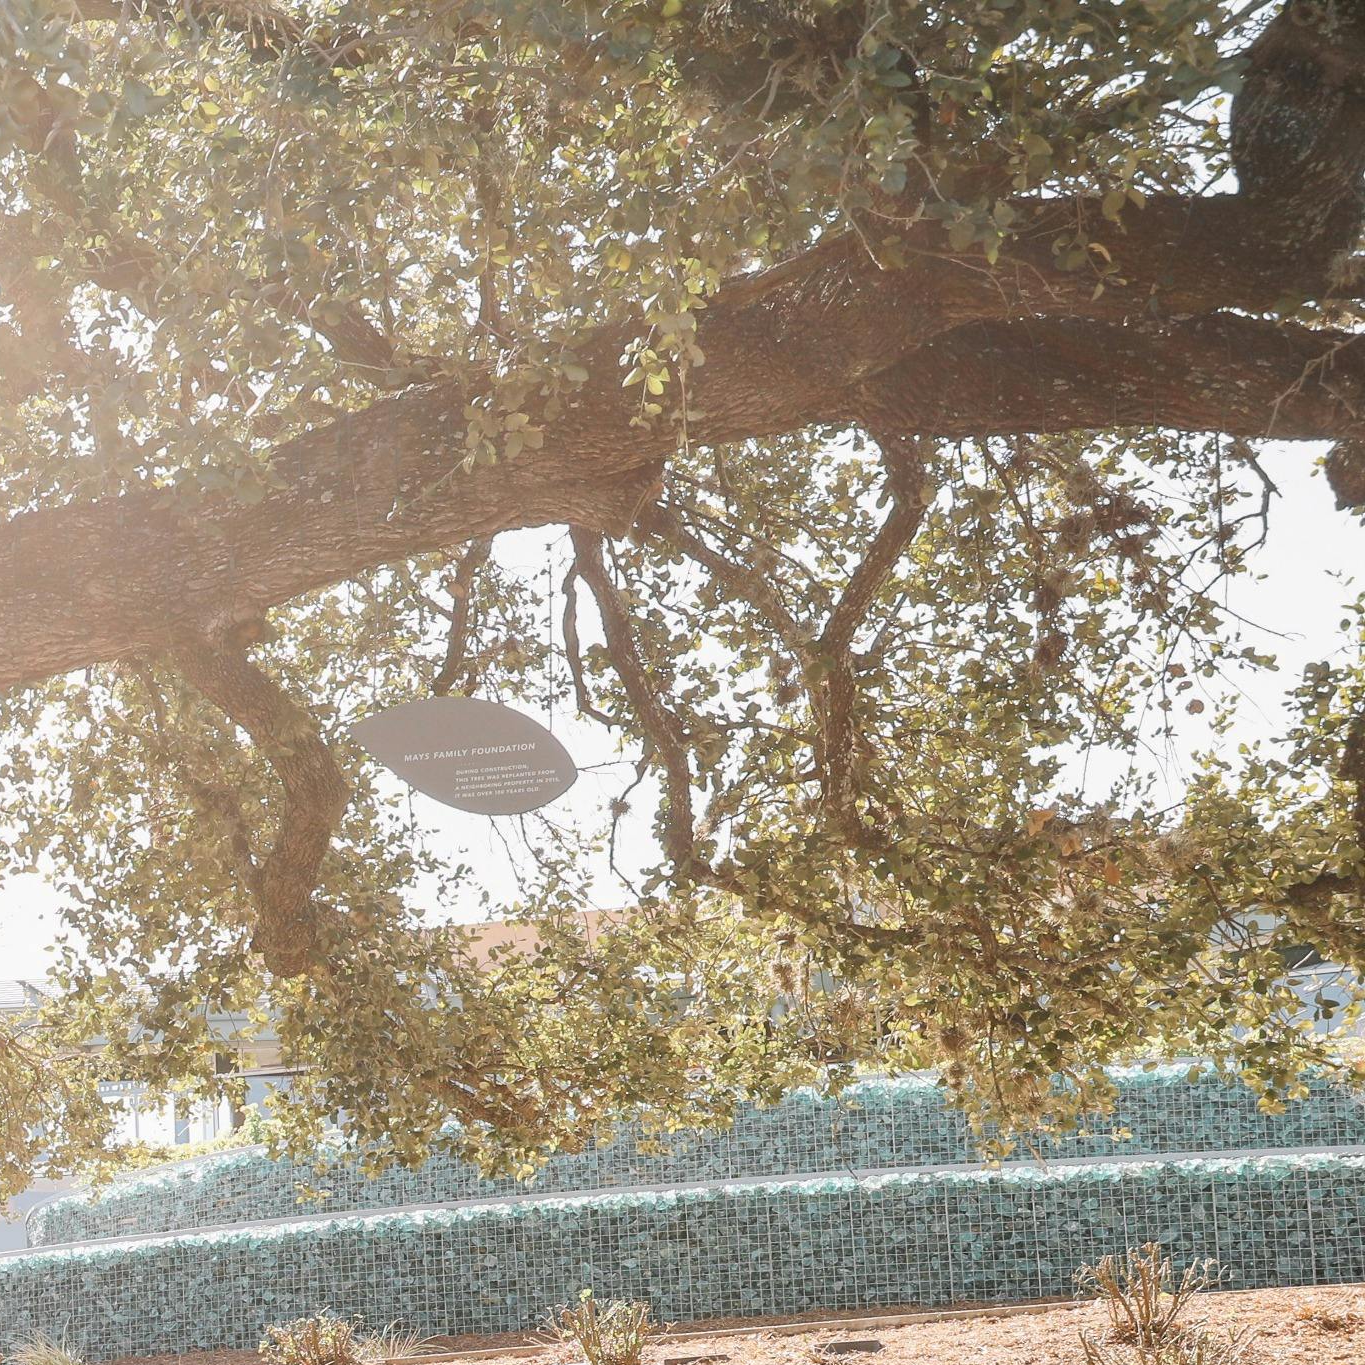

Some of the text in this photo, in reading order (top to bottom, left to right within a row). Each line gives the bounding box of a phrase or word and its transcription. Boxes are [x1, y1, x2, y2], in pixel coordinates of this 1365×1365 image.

[404, 742, 536, 762] MAYS FAMILY FOUNDATION
[455, 767, 479, 776] DURING
[501, 770, 537, 780] REPLANTED
[460, 781, 502, 791] NEIGHBORING
[505, 787, 525, 795] YEARS
